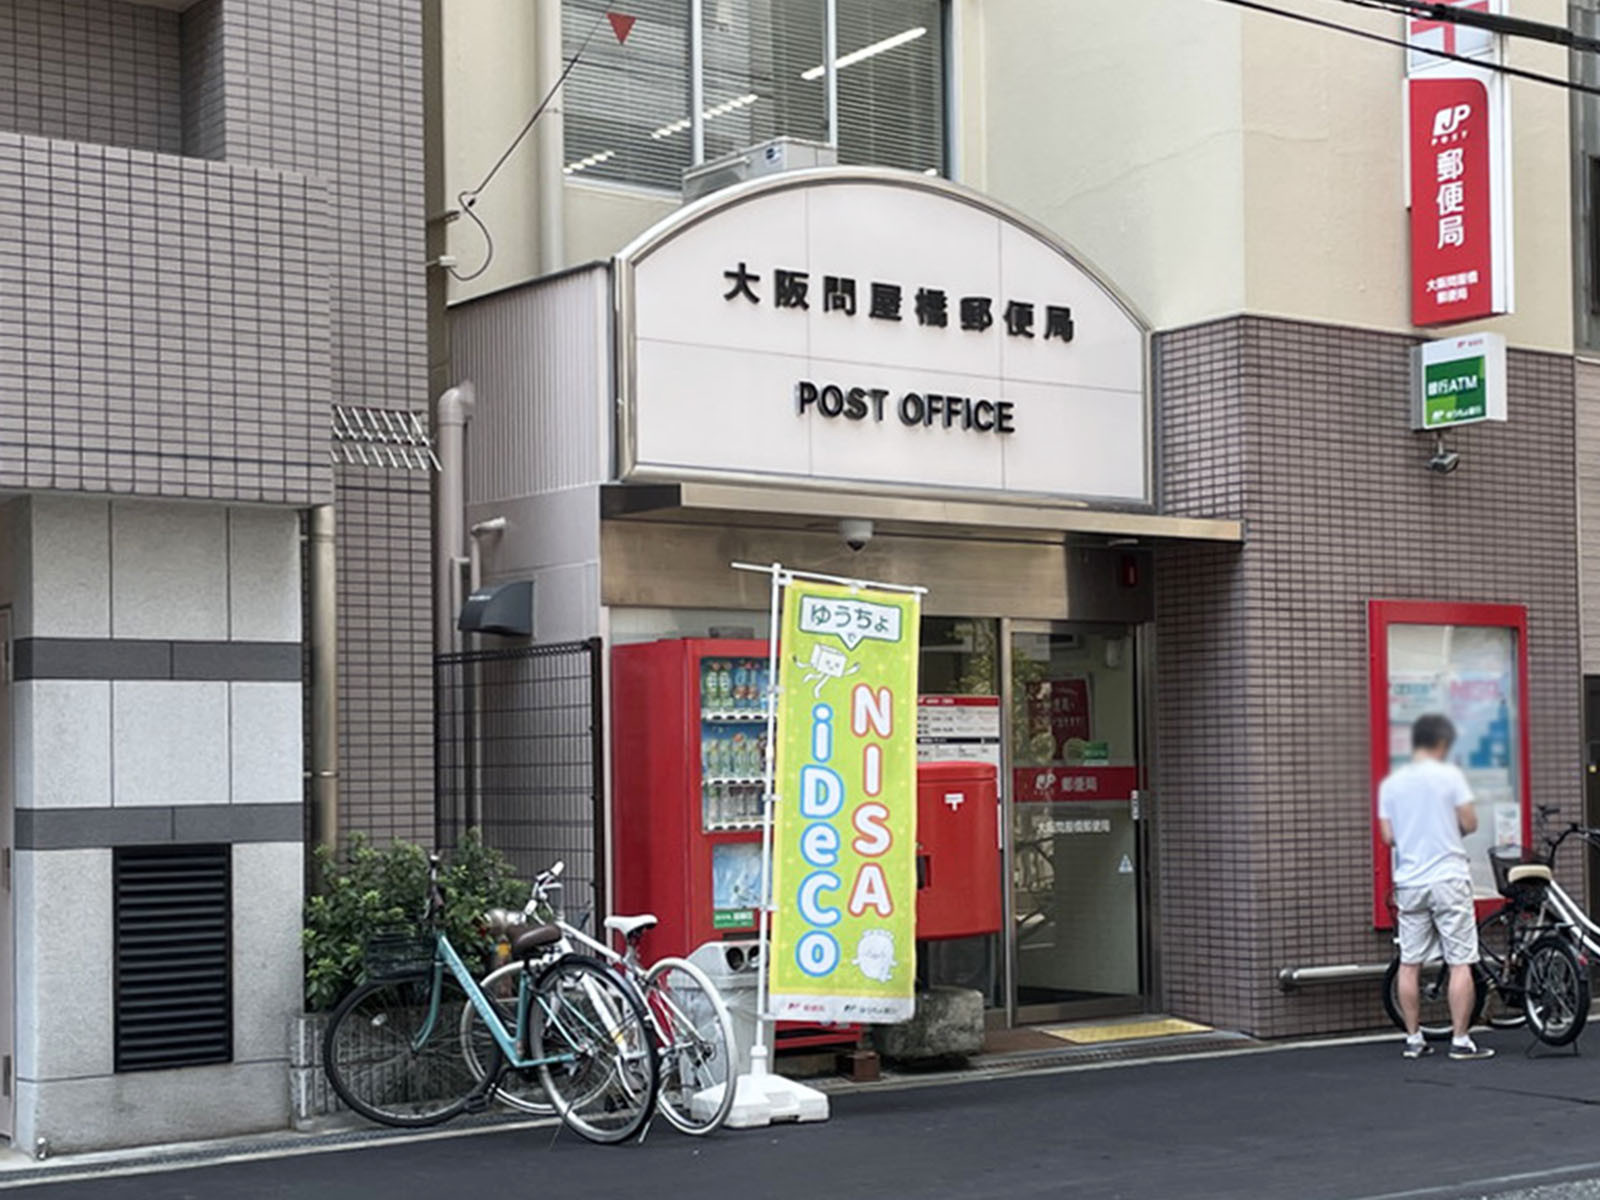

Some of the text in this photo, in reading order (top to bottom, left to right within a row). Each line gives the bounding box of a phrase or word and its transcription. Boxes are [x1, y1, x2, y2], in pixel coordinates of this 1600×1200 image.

[1436, 147, 1465, 250] 郵便局
[723, 262, 1075, 343] 大阪問屋橋郵便局
[796, 381, 1015, 433] POST OFFICE
[811, 604, 889, 632] ゆうちょ
[796, 703, 843, 977] iDeCo
[848, 683, 893, 918] NISA
